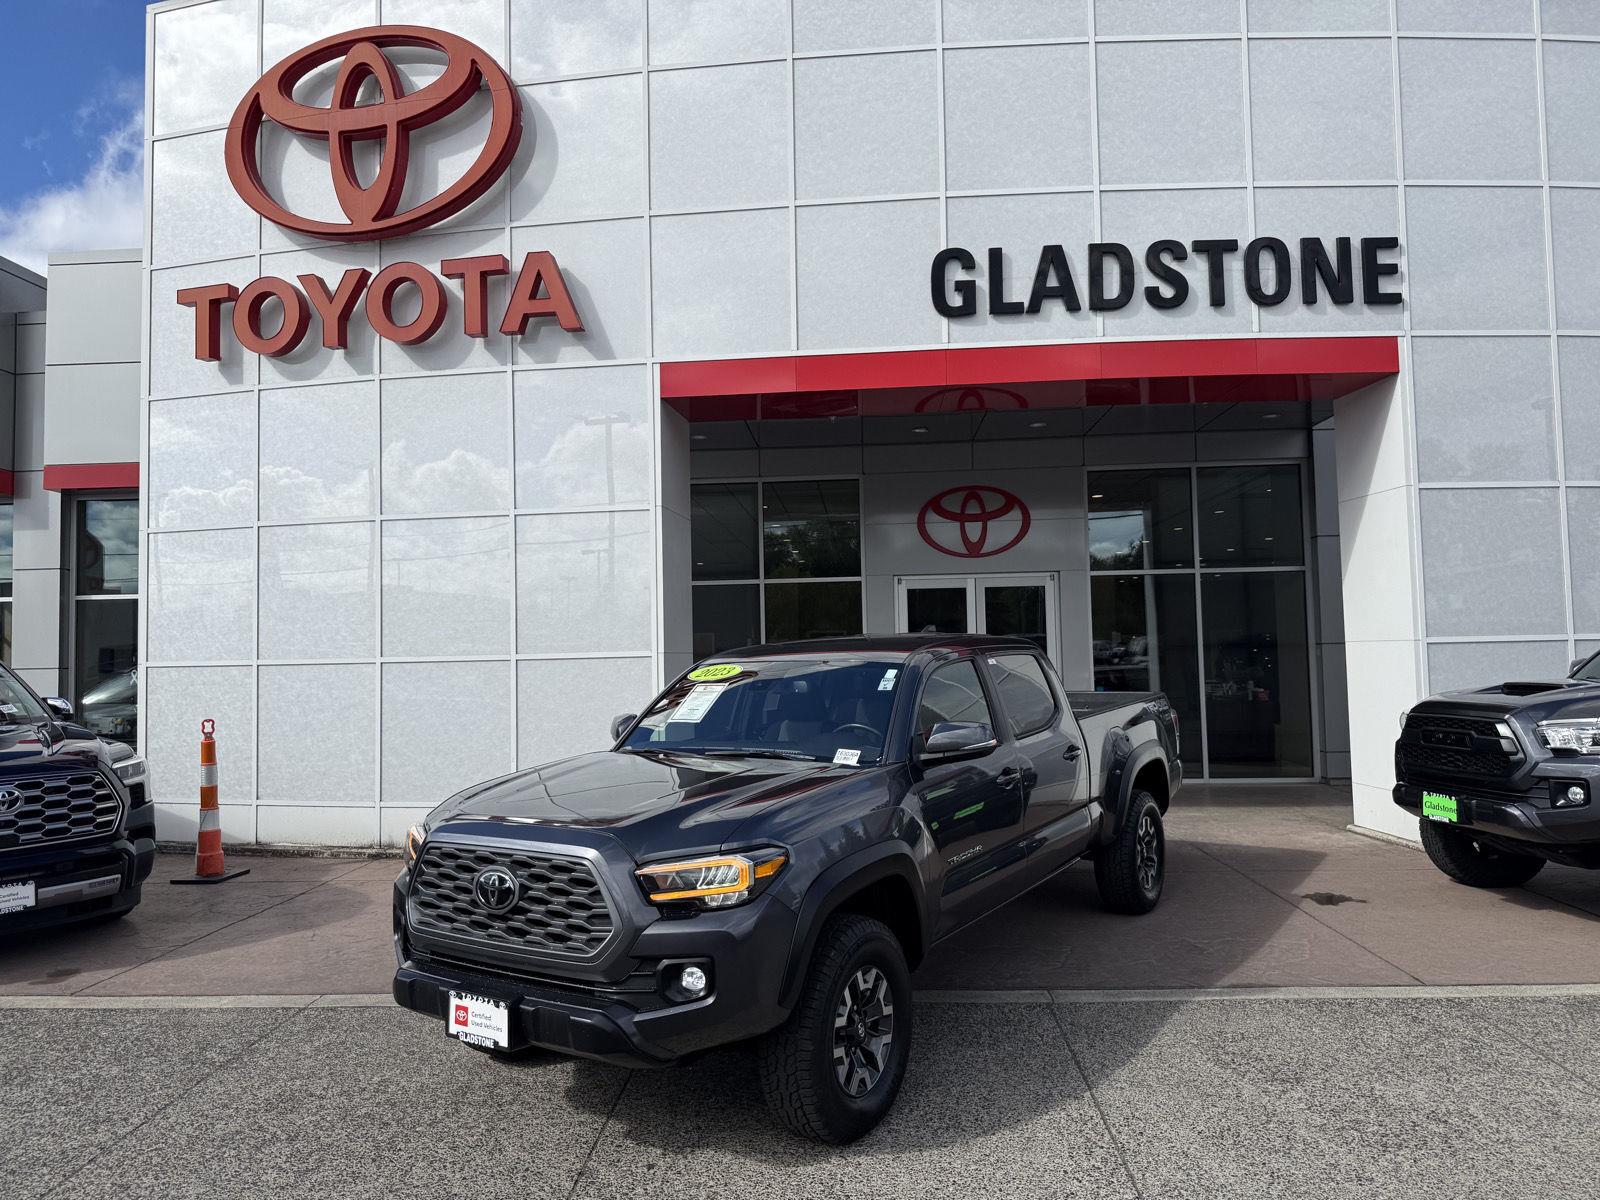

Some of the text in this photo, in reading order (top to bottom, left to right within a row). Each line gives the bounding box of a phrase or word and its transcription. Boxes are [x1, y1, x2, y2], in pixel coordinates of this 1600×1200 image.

[931, 237, 1403, 317] GLADSTONE
[177, 251, 585, 362] TOYOTA
[695, 667, 736, 678] 2023
[461, 993, 495, 1007] TOYOTA
[471, 1010, 492, 1022] Certified
[471, 1020, 503, 1034] Used Vehicles
[459, 1031, 495, 1048] GLADSTONE
